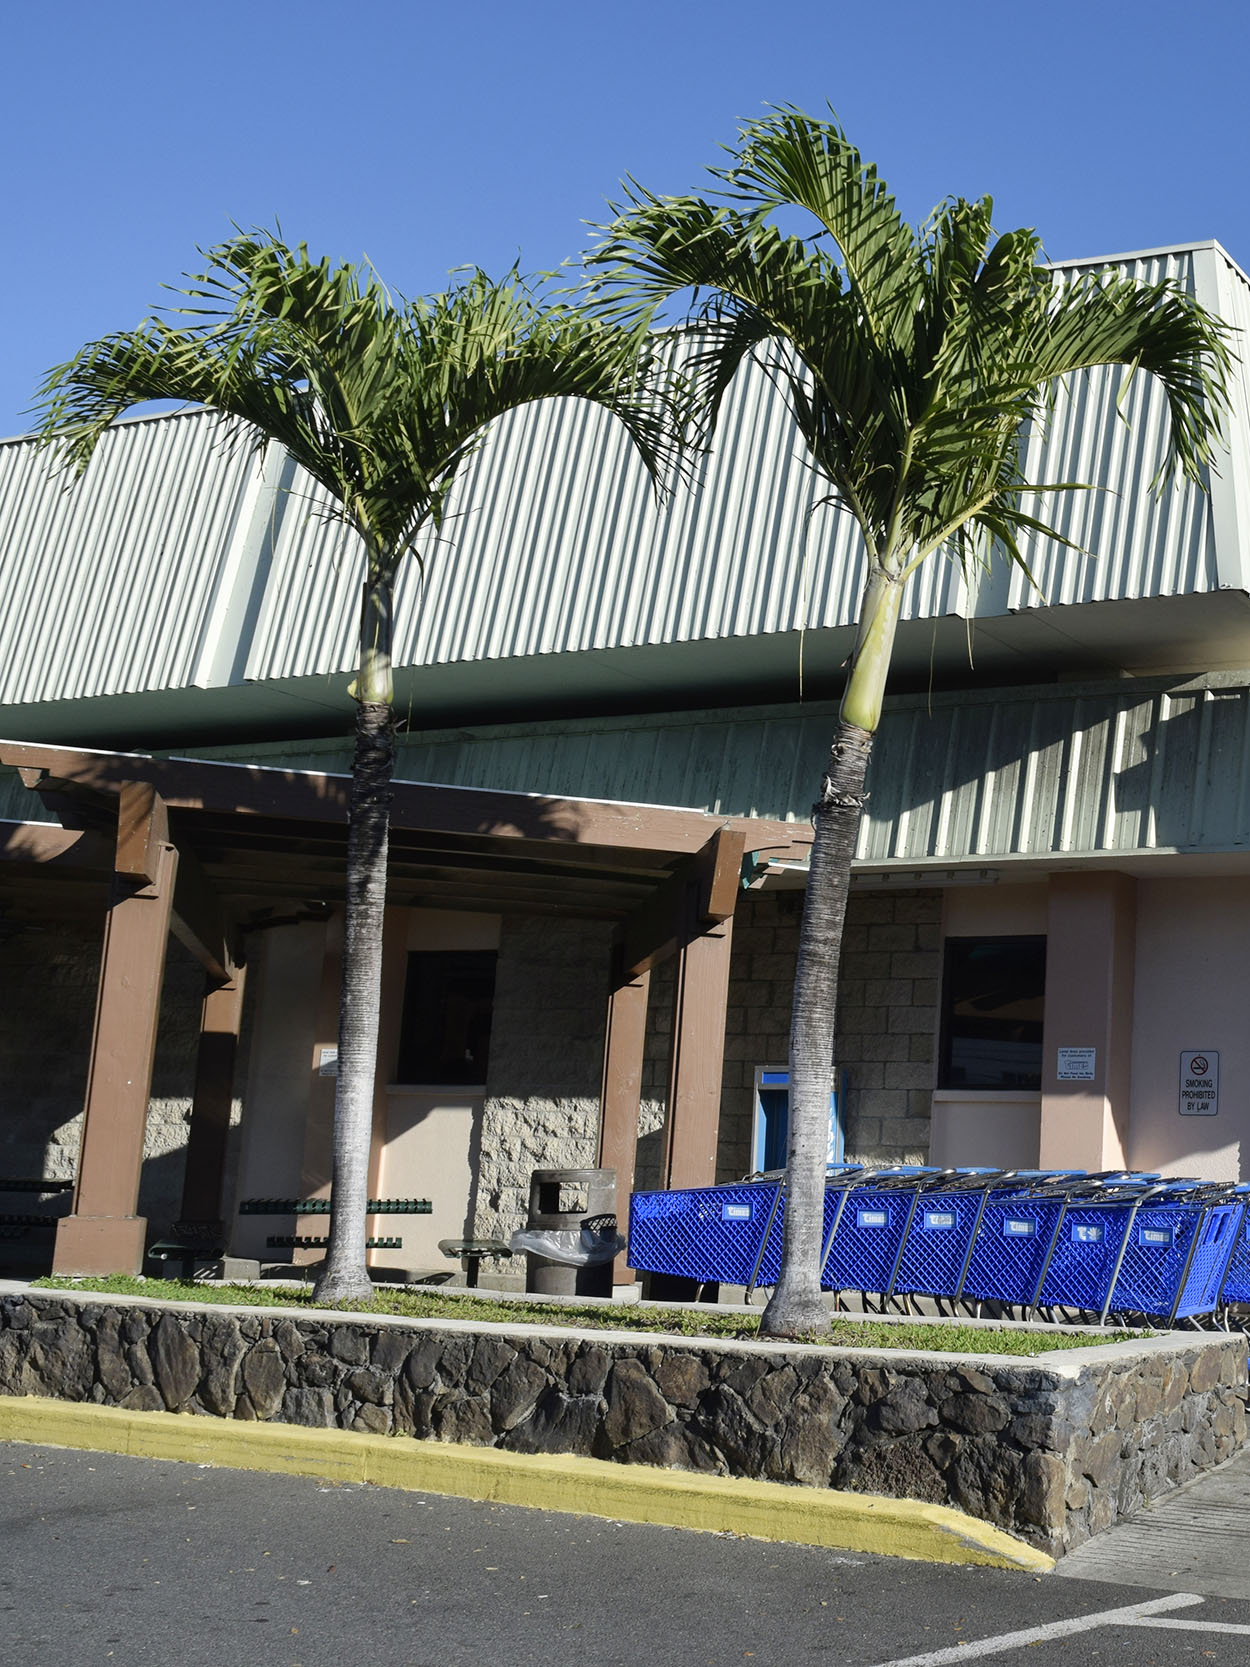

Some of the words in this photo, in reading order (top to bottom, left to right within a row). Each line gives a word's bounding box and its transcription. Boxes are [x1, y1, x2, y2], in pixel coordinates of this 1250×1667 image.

[1185, 1080, 1213, 1088] SMOKING
[1182, 1090, 1216, 1099] PROHIBITED
[1187, 1102, 1195, 1110] BY
[1197, 1102, 1210, 1111] LAW
